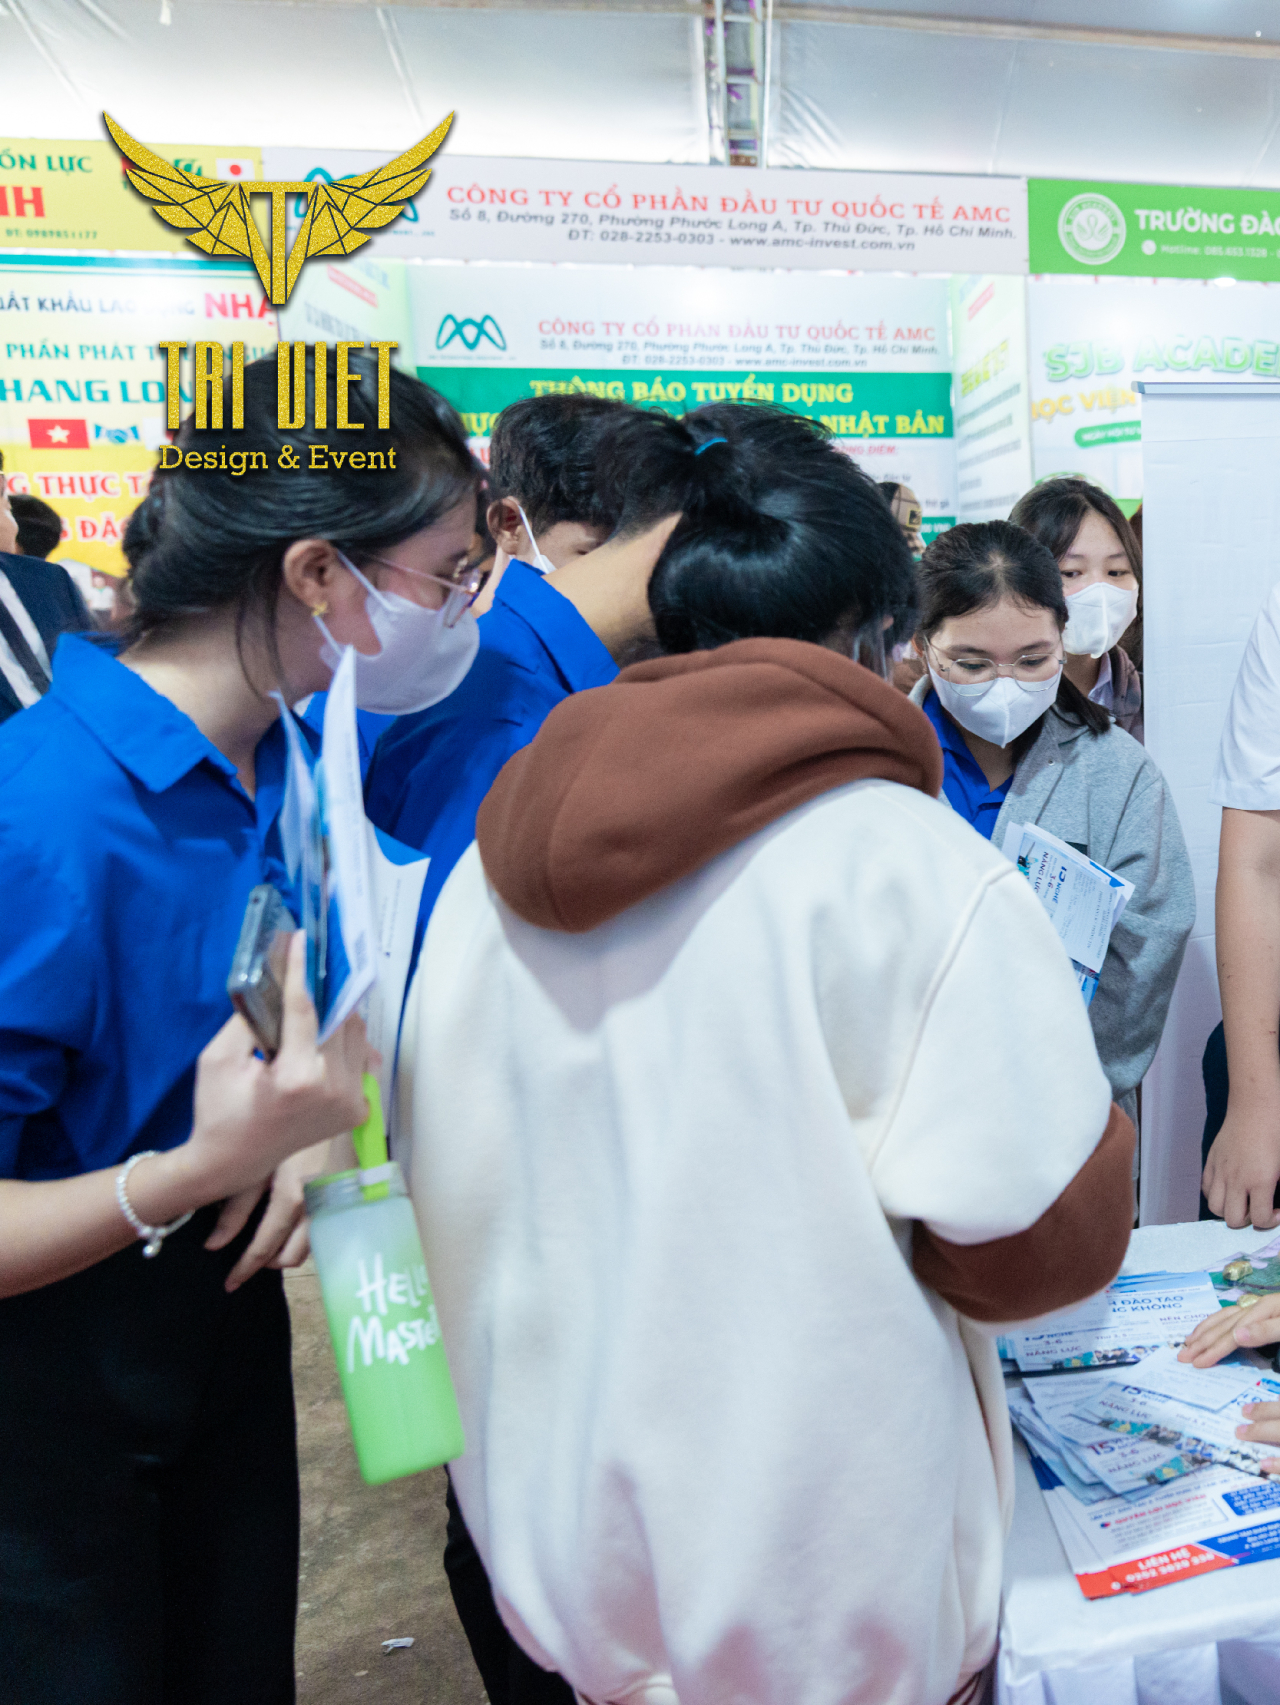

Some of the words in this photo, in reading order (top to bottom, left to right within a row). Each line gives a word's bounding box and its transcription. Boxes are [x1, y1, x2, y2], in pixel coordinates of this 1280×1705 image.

[46, 154, 93, 176] LỰC
[447, 183, 529, 206] CÔNG
[538, 190, 573, 207] TY
[584, 184, 622, 209] CỔ
[632, 186, 708, 212] PHẦN
[720, 189, 777, 215] ĐẦU
[787, 198, 824, 216] TƯ
[832, 194, 905, 220] QUỐC
[913, 196, 945, 220] TẾ
[952, 205, 1011, 223] AMC
[497, 211, 555, 226] Đường
[562, 212, 593, 226] 270,
[600, 214, 664, 230] Phường
[670, 216, 723, 230] Phước
[728, 219, 768, 233] Long
[772, 220, 787, 233] A,
[794, 221, 816, 234] Tp.
[855, 222, 891, 236] Đức,
[897, 224, 918, 238] Tp.
[949, 225, 973, 237] Chí
[978, 226, 1017, 240] Minh.
[1134, 207, 1235, 235] TRƯỜNG
[568, 229, 594, 242] ĐT:
[600, 231, 714, 245] 028-2253-0303
[729, 236, 915, 251] www.amc-invest.com.vn
[204, 292, 276, 327] NHẬ
[538, 317, 595, 336] CÔNG
[602, 322, 625, 337] TY
[775, 324, 801, 340] TƯ
[806, 319, 860, 341] QUỐC
[865, 319, 888, 341] TẾ
[893, 326, 936, 342] AMC
[79, 340, 135, 361] PHÁT
[733, 343, 762, 355] Long
[1045, 340, 1125, 381] SJB
[632, 375, 687, 402] BÁO
[691, 373, 776, 403] TUYỂN
[781, 382, 854, 407] DỤNG
[819, 410, 890, 438] NHẬT
[895, 409, 945, 435] BẢN
[38, 475, 121, 500] THỰC
[80, 515, 129, 543] ĐẶ
